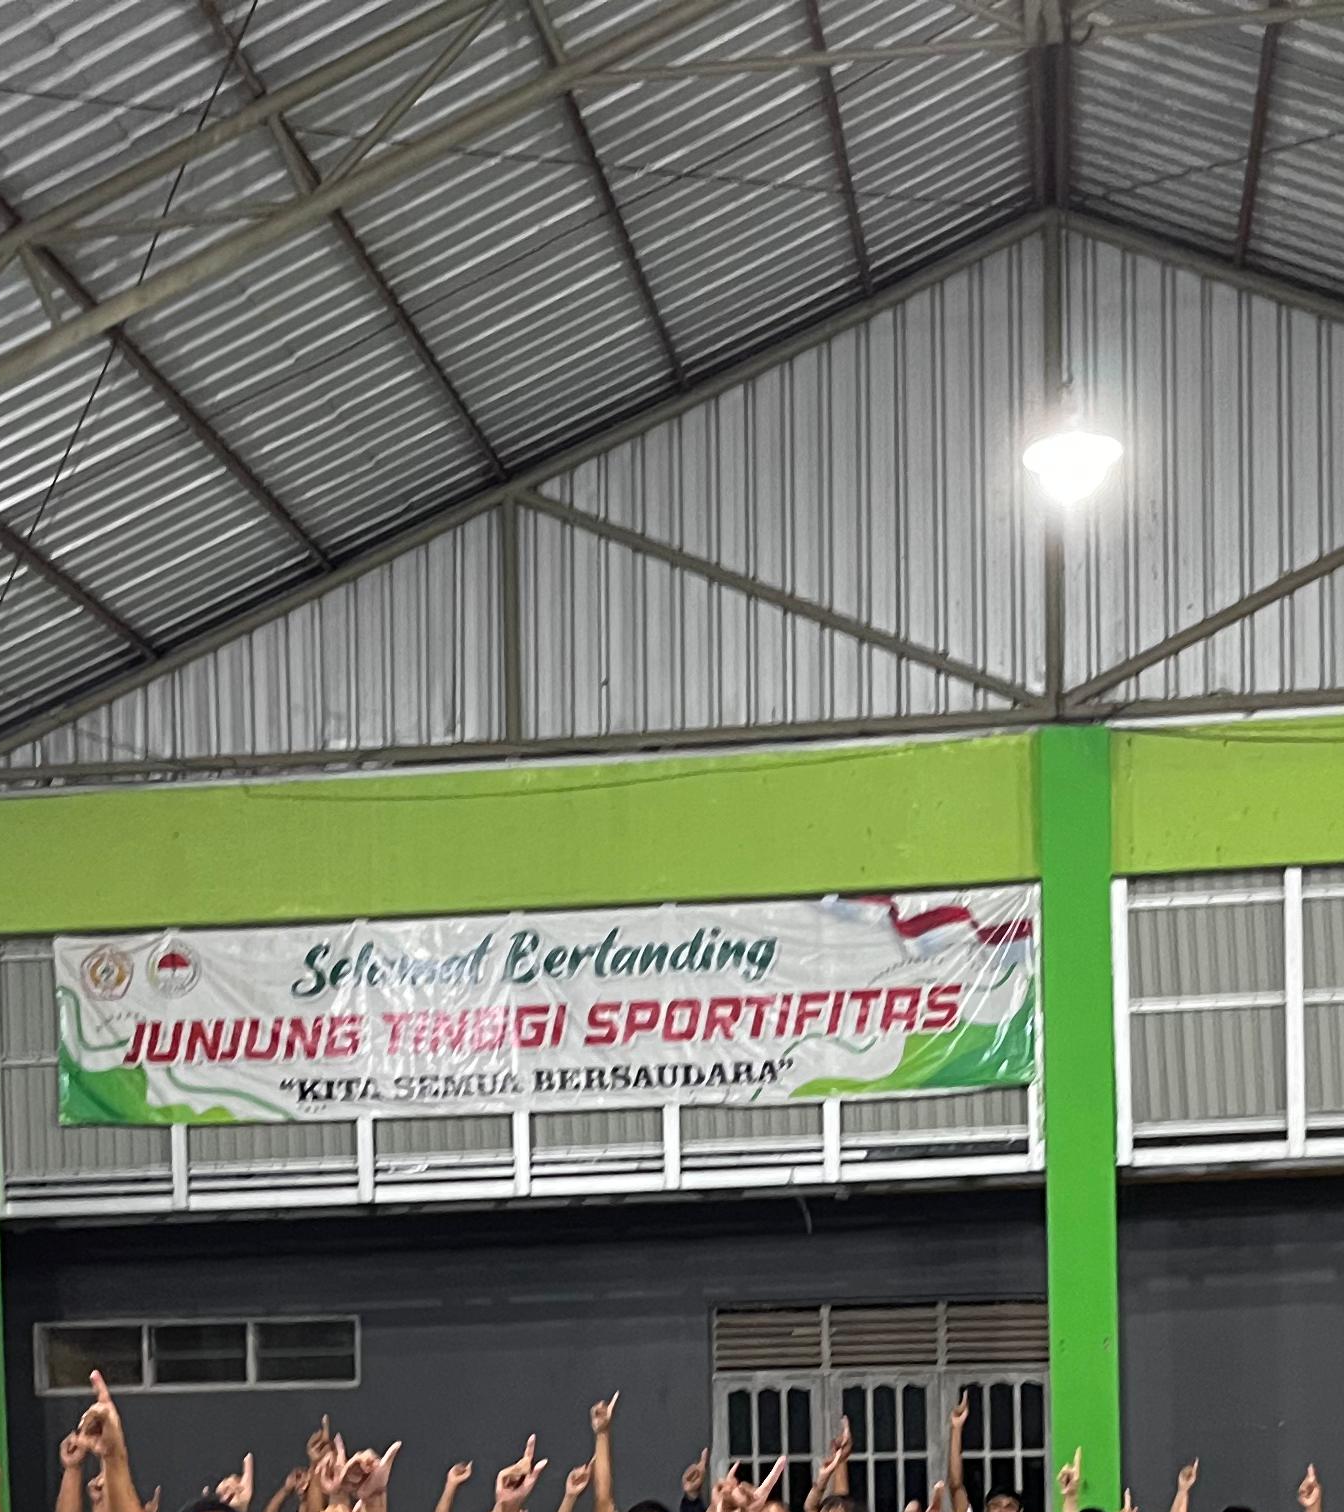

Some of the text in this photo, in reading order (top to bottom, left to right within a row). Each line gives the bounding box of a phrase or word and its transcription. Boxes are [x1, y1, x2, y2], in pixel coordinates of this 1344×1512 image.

[502, 926, 778, 983] Bertanding
[122, 985, 963, 1065] JUNJUNG TINGGI SPORTIFITAS
[393, 1072, 524, 1100] SEMUA
